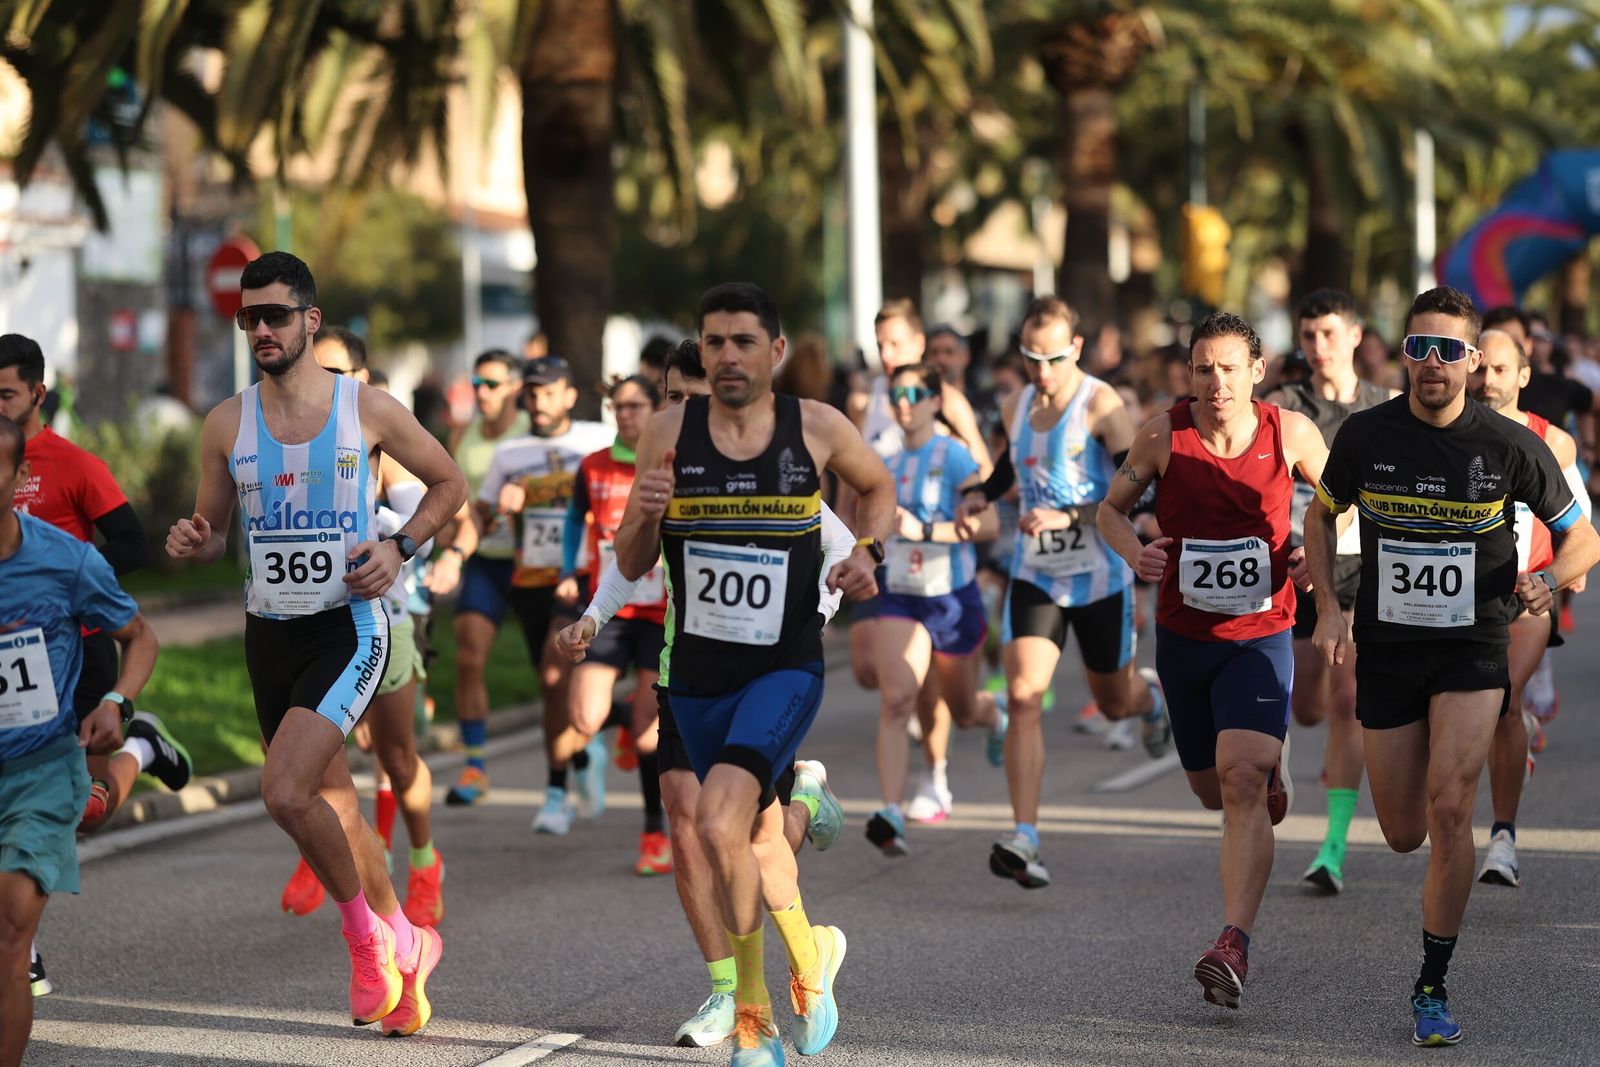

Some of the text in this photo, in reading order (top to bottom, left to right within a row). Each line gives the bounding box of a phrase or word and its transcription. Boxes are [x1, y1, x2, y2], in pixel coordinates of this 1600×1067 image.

[235, 454, 257, 466] vive
[681, 465, 705, 475] vive
[1373, 463, 1396, 473] vive
[249, 500, 358, 533] málaga
[703, 500, 757, 515] TRIATLÓN
[1391, 503, 1449, 517] TRIATLÓN
[1035, 527, 1086, 556] 152
[264, 550, 333, 584] 369
[1193, 557, 1260, 589] 268
[1391, 562, 1462, 597] 340
[698, 567, 771, 609] 200
[353, 636, 382, 696] málaga
[340, 703, 355, 722] vive
